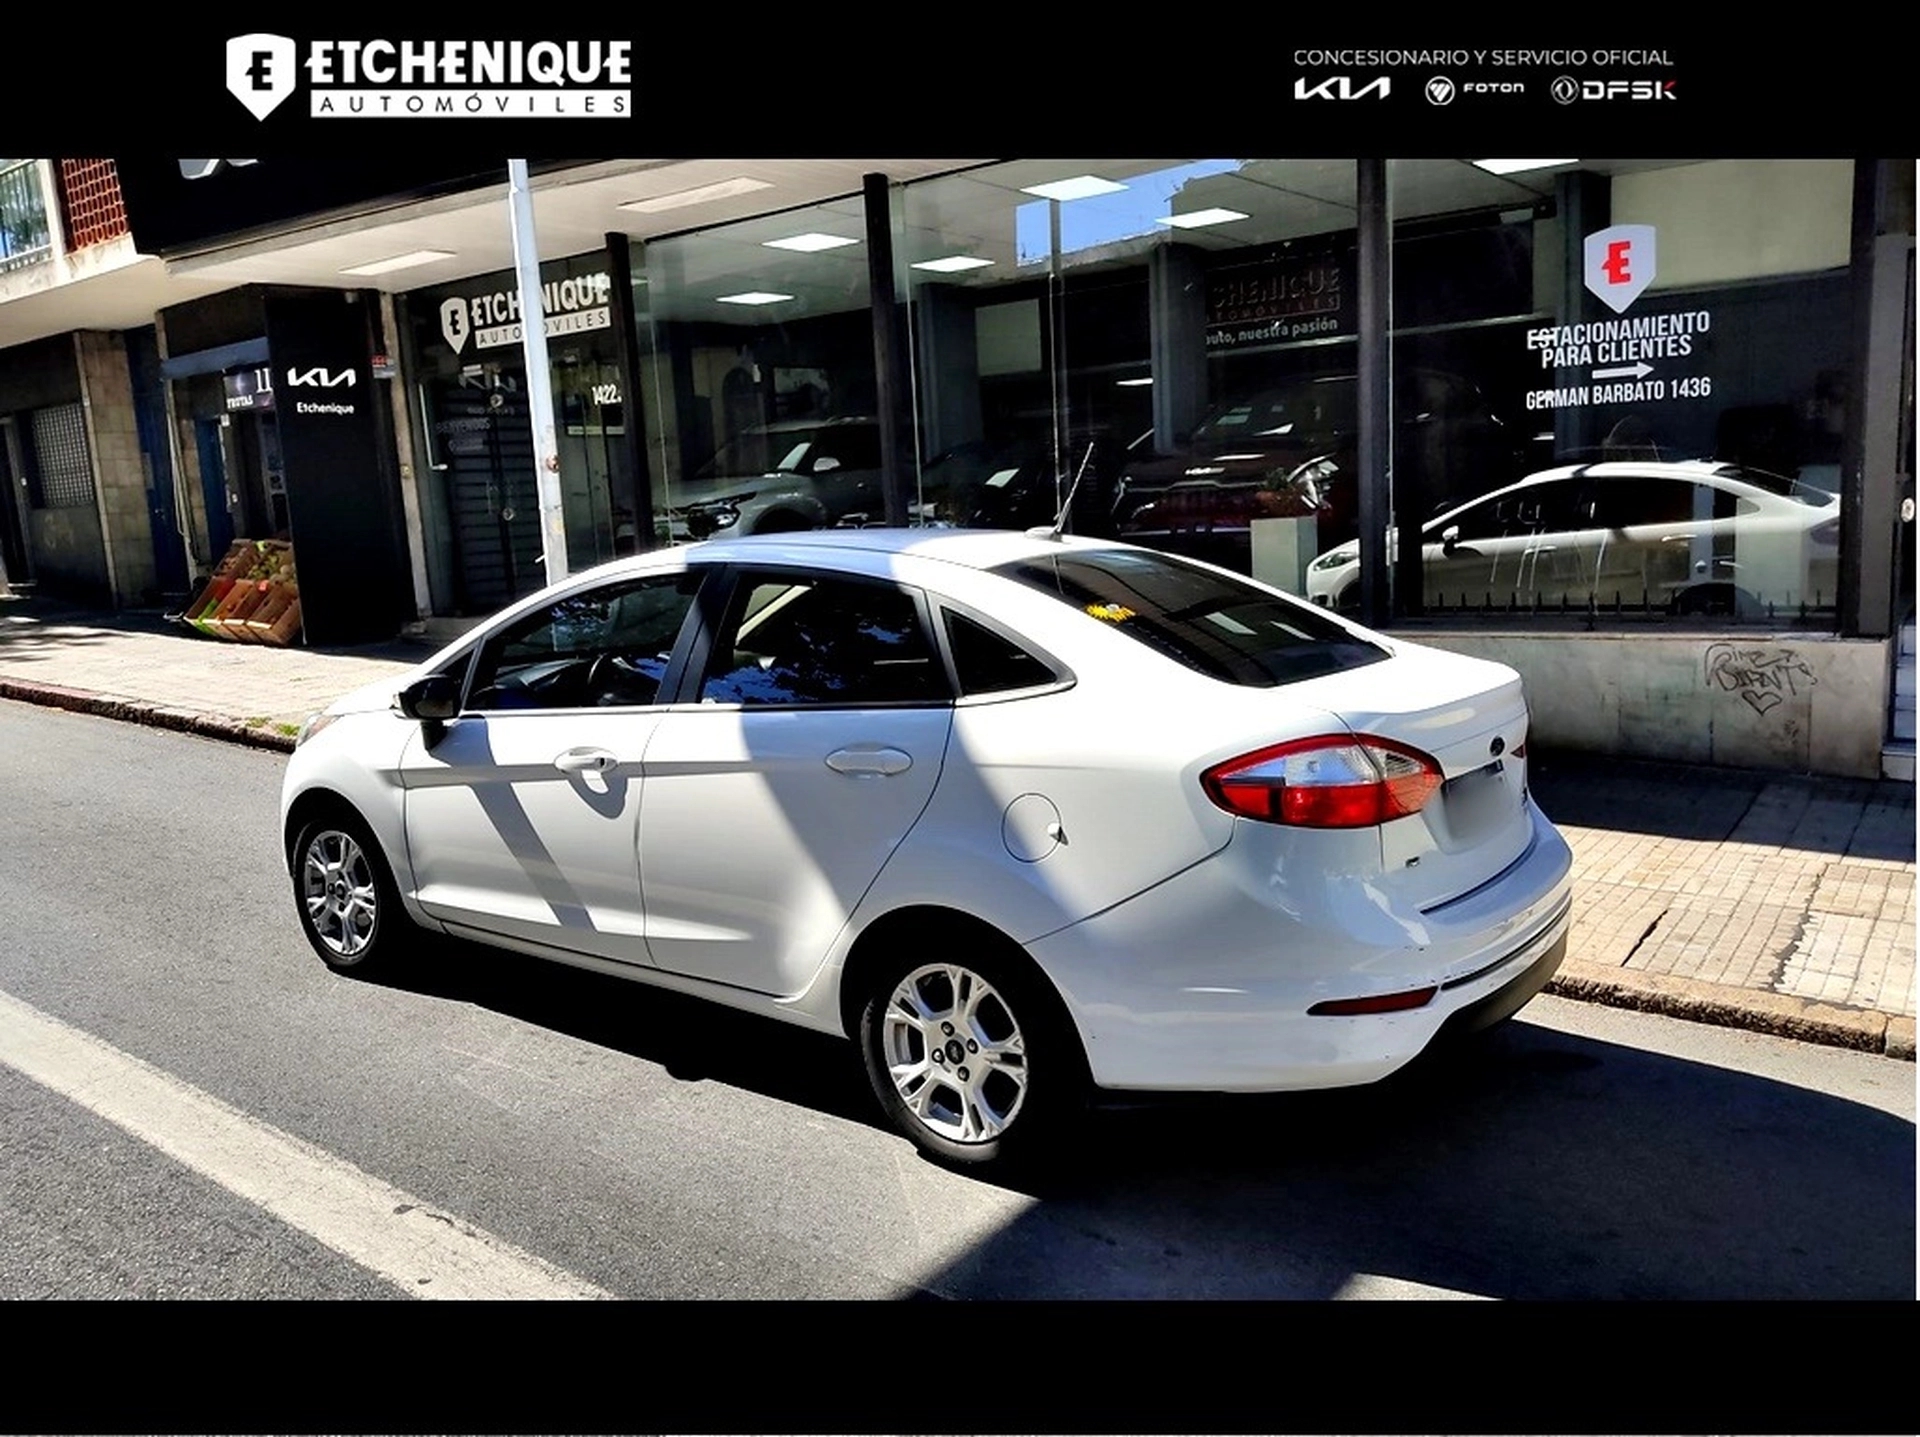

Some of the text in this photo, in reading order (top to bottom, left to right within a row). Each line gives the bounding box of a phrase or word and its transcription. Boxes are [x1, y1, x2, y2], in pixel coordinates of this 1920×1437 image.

[1602, 241, 1631, 285] E
[471, 272, 611, 327] ETCHNIQUE
[1212, 266, 1341, 309] CHENIQUE
[479, 312, 606, 345] AUTOVILES
[1238, 322, 1289, 342] nuestra
[1291, 316, 1338, 338] pasión
[1527, 310, 1710, 350] ESTACIONAMIENTO
[1542, 334, 1692, 369] PARA CLIENTES
[287, 366, 356, 388] KIA
[1526, 376, 1711, 410] GERMAN BARBATO 1436
[296, 402, 355, 416] Etchenique
